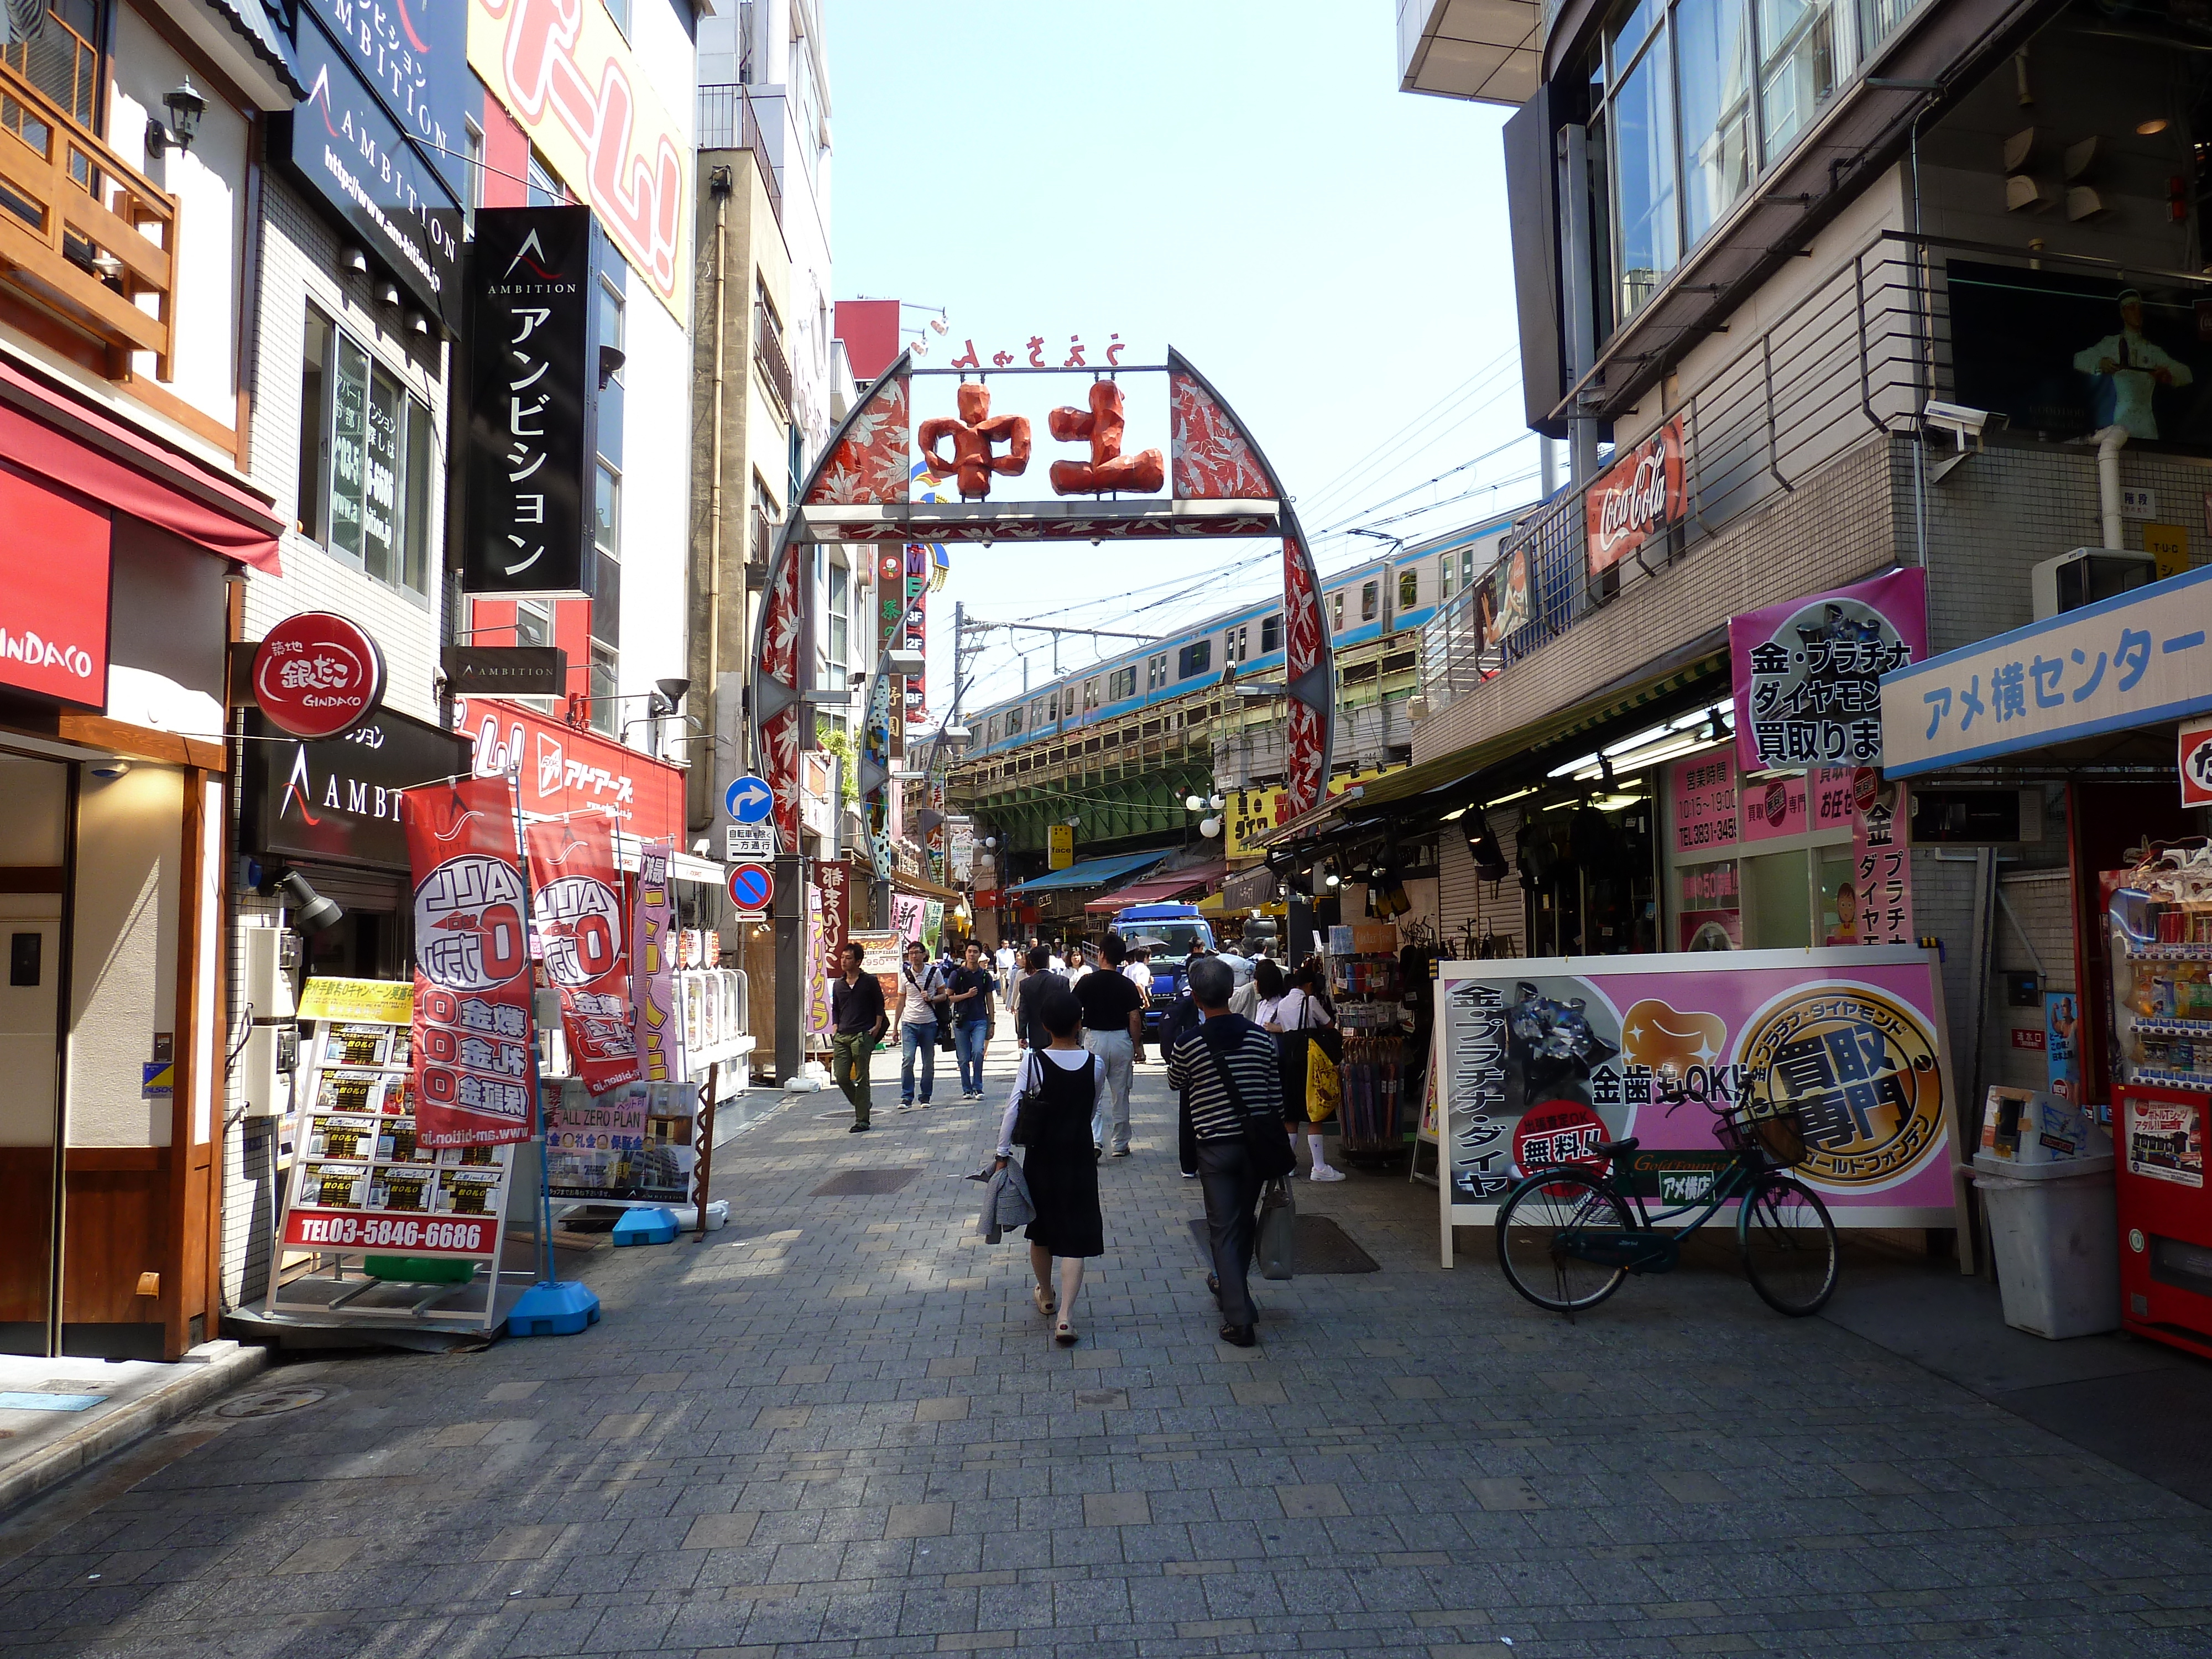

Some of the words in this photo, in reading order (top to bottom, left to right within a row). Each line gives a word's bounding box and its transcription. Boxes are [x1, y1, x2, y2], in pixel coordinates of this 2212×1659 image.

[332, 0, 447, 159] MBITION
[341, 111, 456, 263] AMBITION
[488, 284, 576, 294] AMBITION
[504, 308, 551, 576] アンビション
[1599, 441, 1666, 551] Coca-Cola
[271, 640, 303, 656] 築地
[907, 639, 922, 650] 2F
[1749, 640, 1912, 676] 金・プラチナ
[279, 654, 348, 689] 銀だこ
[479, 667, 554, 676] AMBITION
[1923, 628, 2205, 740] アメ横センター
[302, 695, 361, 707] GINDACO
[1754, 720, 1880, 763] 買取りま
[1687, 761, 1726, 791] 営業時間
[729, 841, 771, 850] 一方通行
[1452, 985, 1508, 1198] 金・プラチナ・ダイヤ
[562, 1110, 581, 1126] ALL
[584, 1109, 610, 1127] ZERO
[613, 1110, 640, 1128] PLAN
[301, 1218, 482, 1249] TEL03-5846-6686
